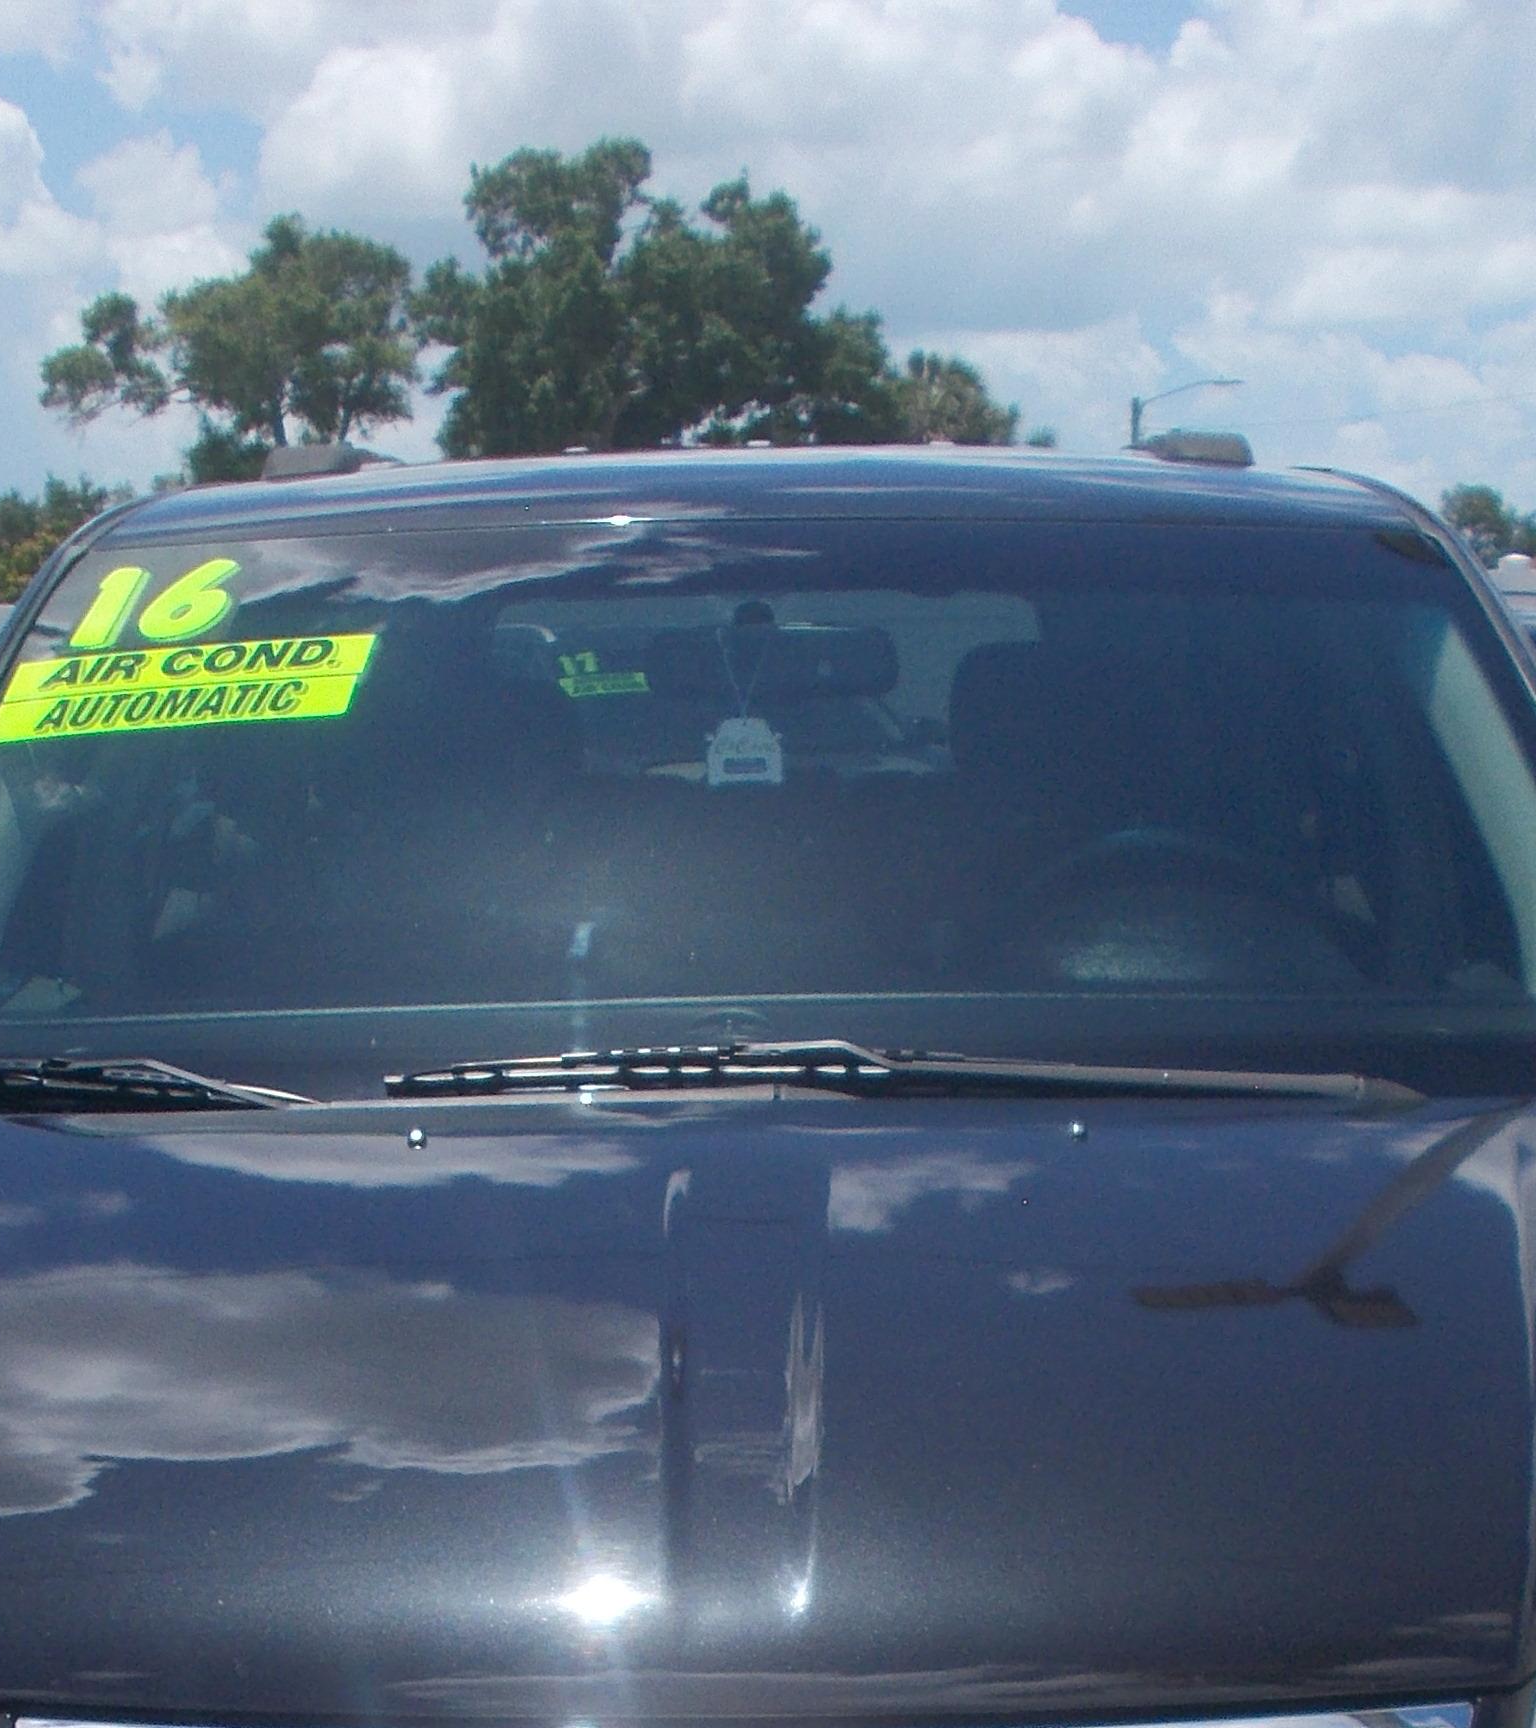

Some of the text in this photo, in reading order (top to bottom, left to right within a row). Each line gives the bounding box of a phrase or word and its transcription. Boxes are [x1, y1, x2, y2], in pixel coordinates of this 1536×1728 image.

[69, 558, 242, 649] 16
[39, 639, 342, 690] AIR COND.
[34, 680, 307, 734] AUTOMATIC
